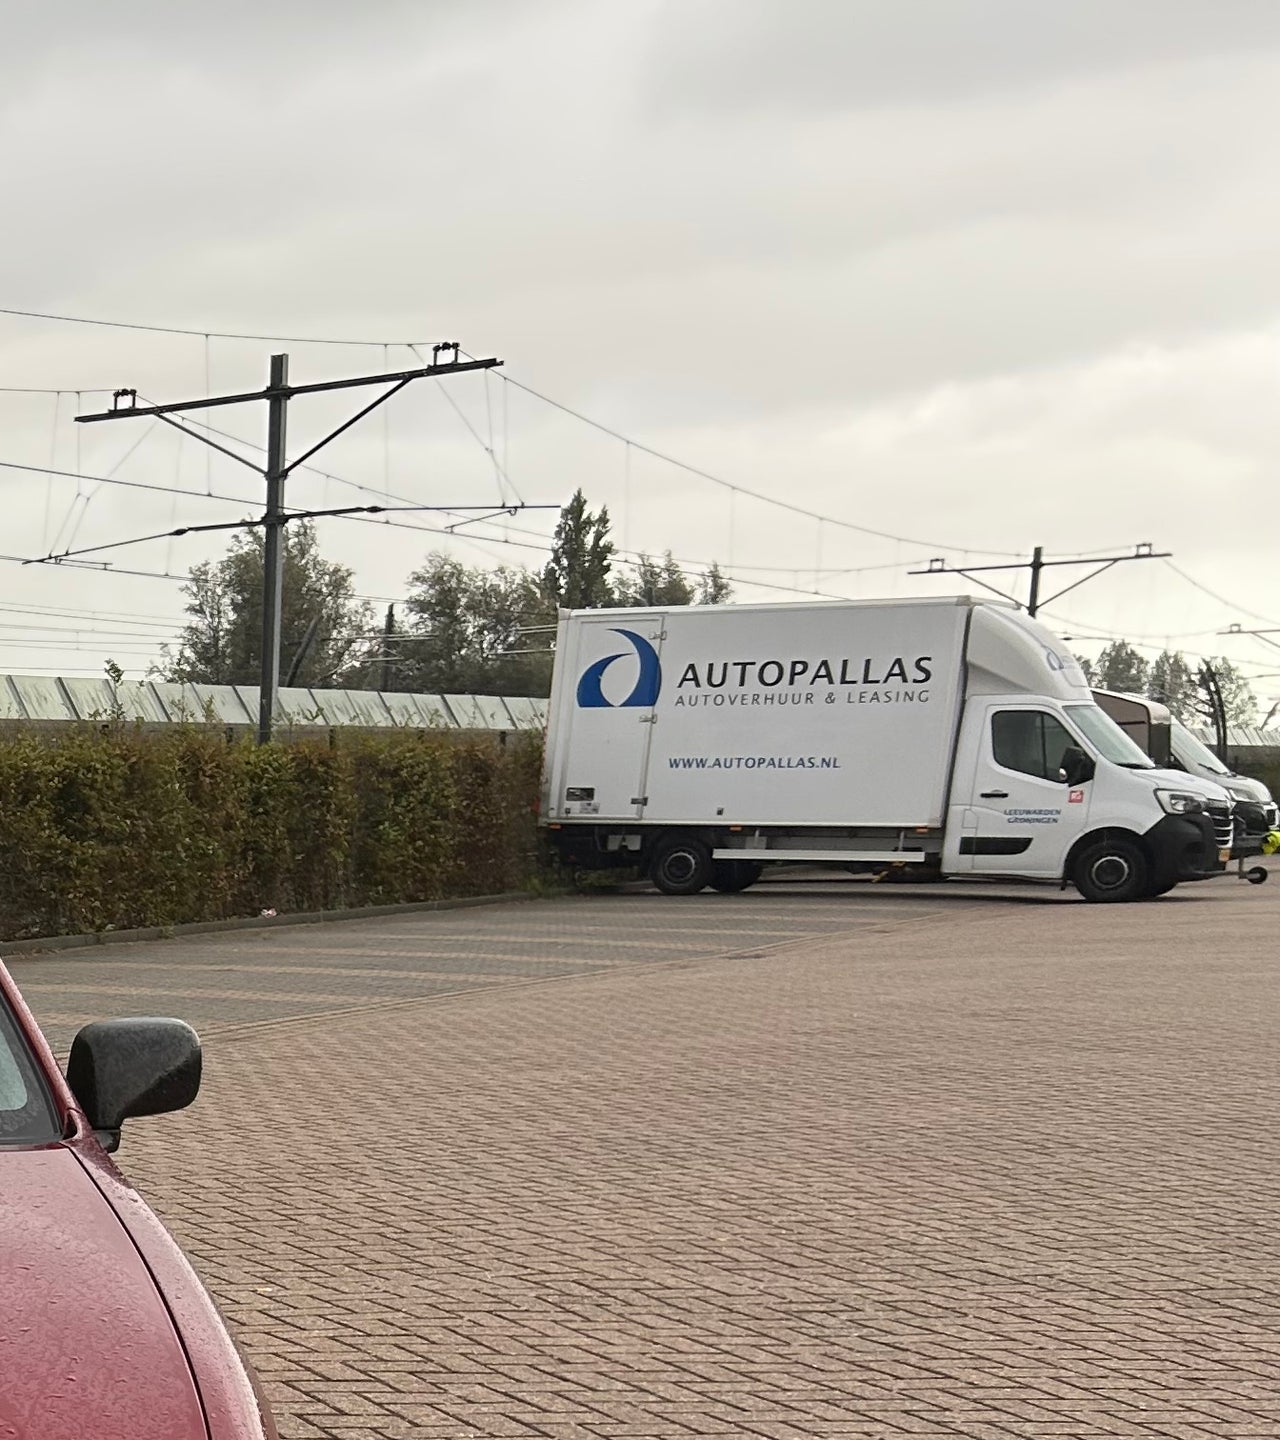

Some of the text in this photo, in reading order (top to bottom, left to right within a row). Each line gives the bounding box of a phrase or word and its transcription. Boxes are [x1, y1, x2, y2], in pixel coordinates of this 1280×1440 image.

[676, 656, 933, 689] AUTOPALLAS
[674, 689, 930, 707] AUTOVERHUUR & LEASING
[668, 756, 841, 769] WWW.AUTOPALLAS.NL
